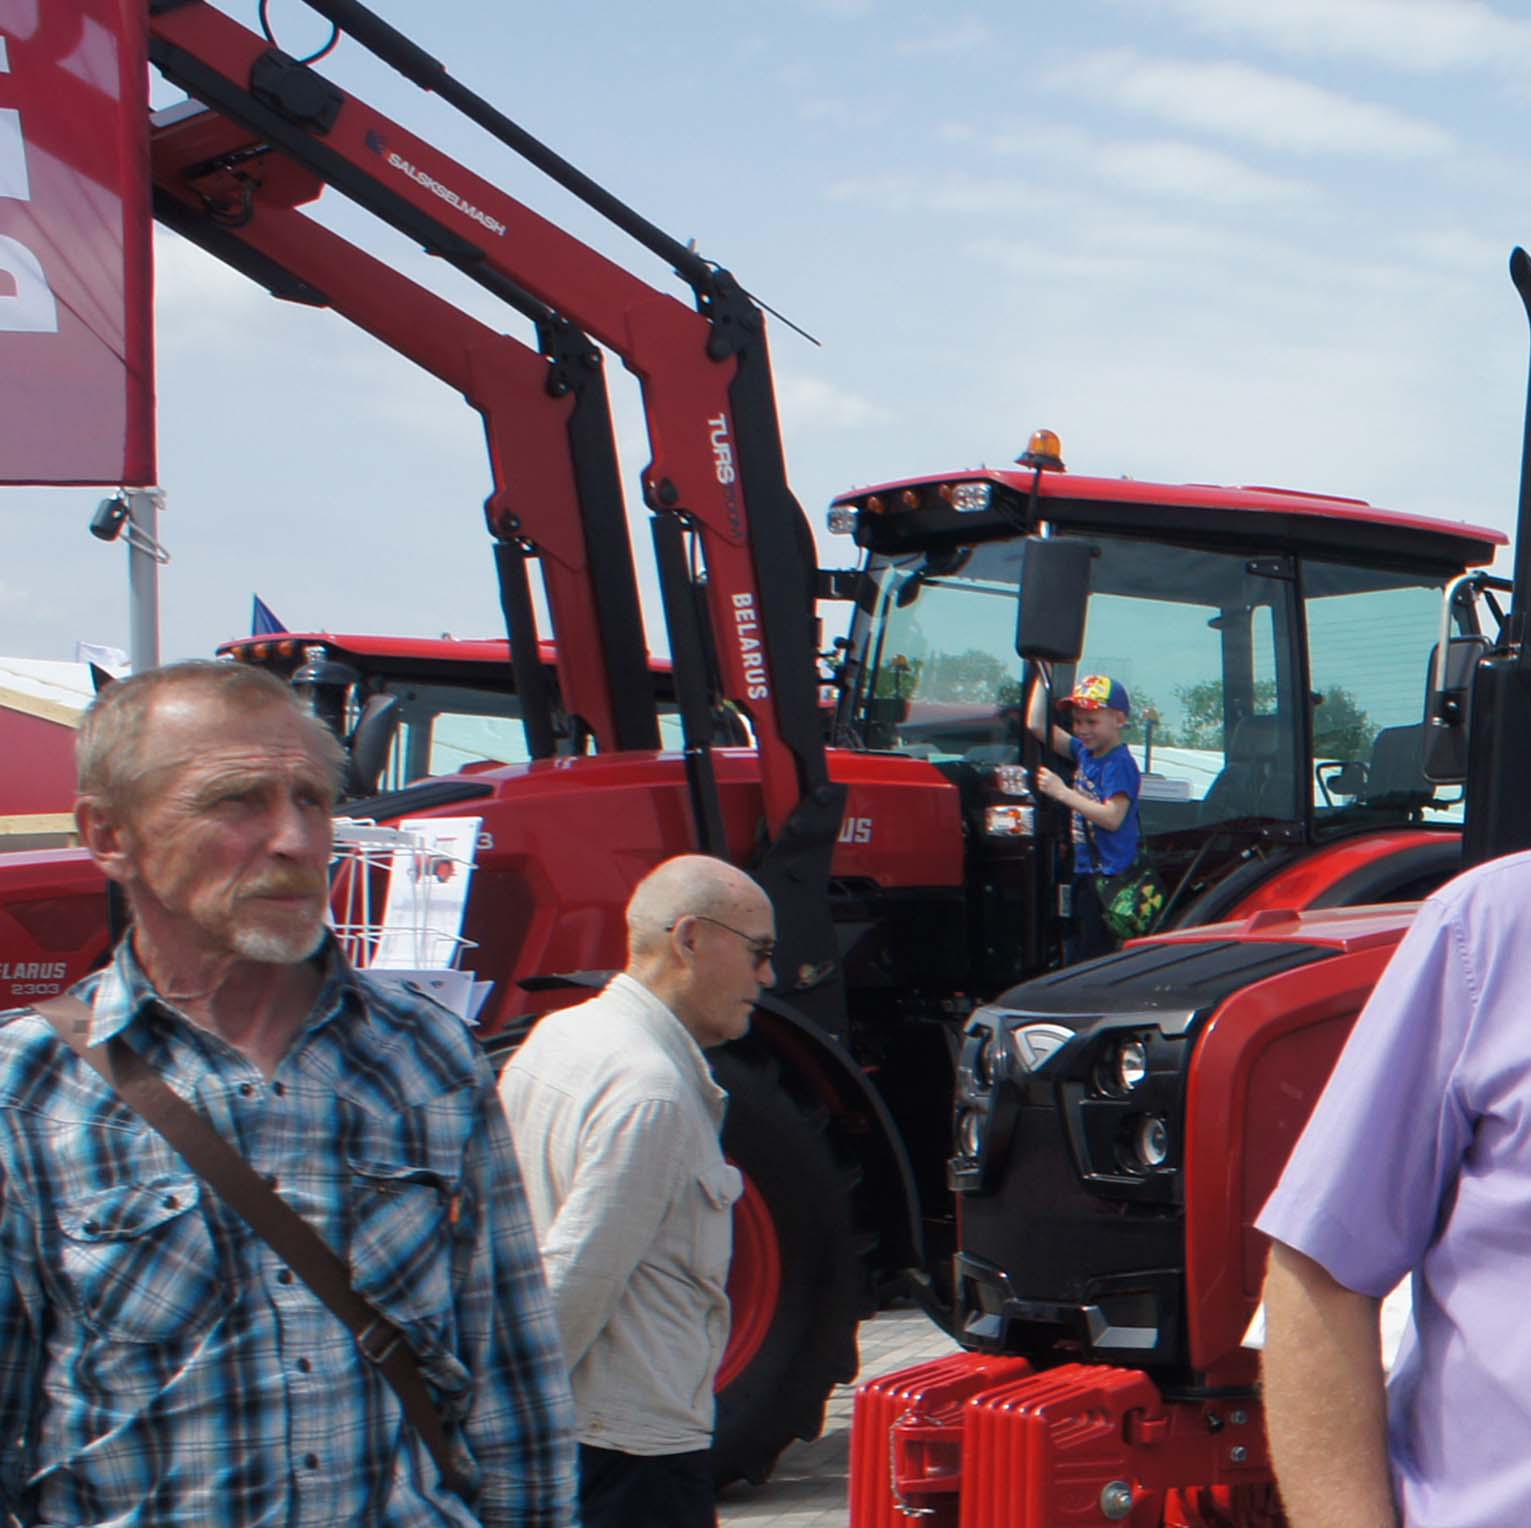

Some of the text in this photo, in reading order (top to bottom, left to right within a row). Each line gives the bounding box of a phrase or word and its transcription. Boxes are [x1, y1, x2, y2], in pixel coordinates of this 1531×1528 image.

[387, 152, 507, 236] SALSKSELMASH
[707, 413, 736, 485] TURS
[732, 593, 769, 700] BELARUS
[0, 962, 67, 979] LARUS
[11, 983, 61, 995] 2303
